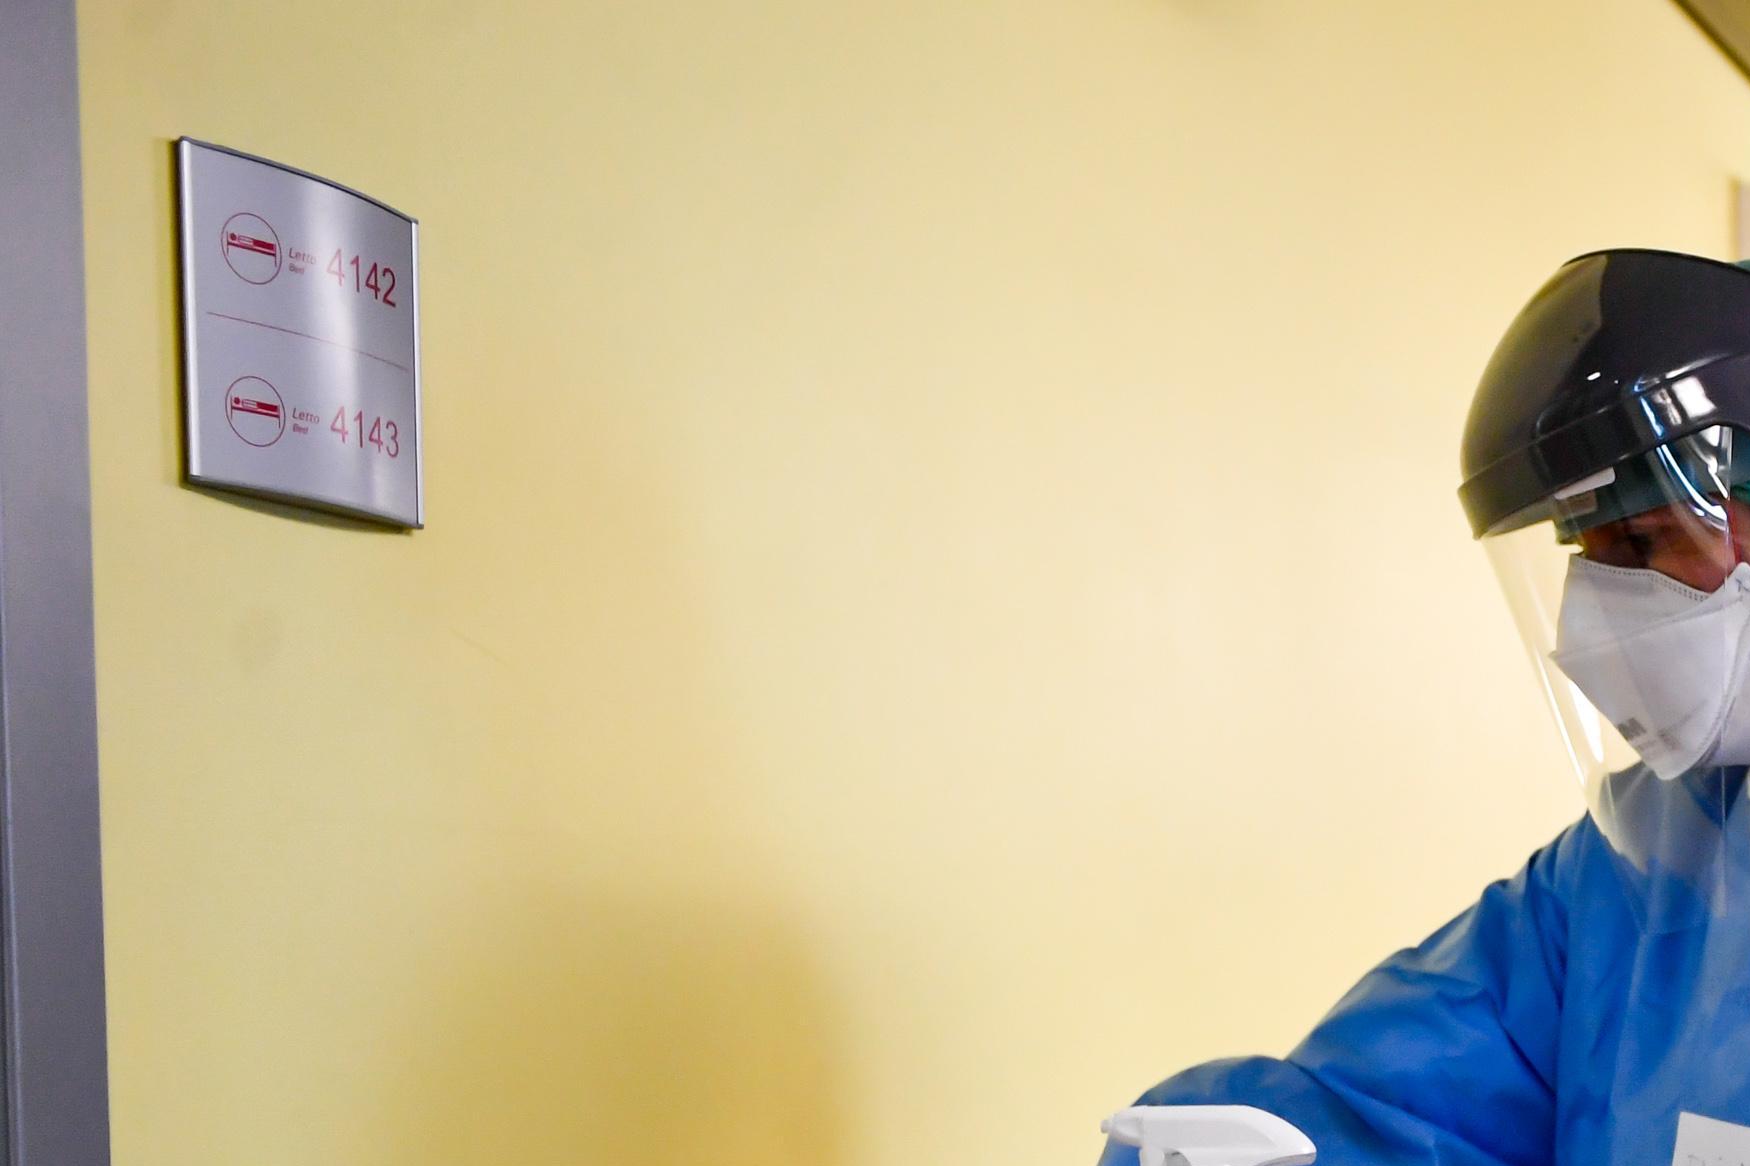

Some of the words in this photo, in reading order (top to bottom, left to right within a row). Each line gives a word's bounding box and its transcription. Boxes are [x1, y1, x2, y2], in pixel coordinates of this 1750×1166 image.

[326, 248, 396, 308] 4142
[292, 407, 320, 424] Letto
[330, 405, 399, 458] 4143
